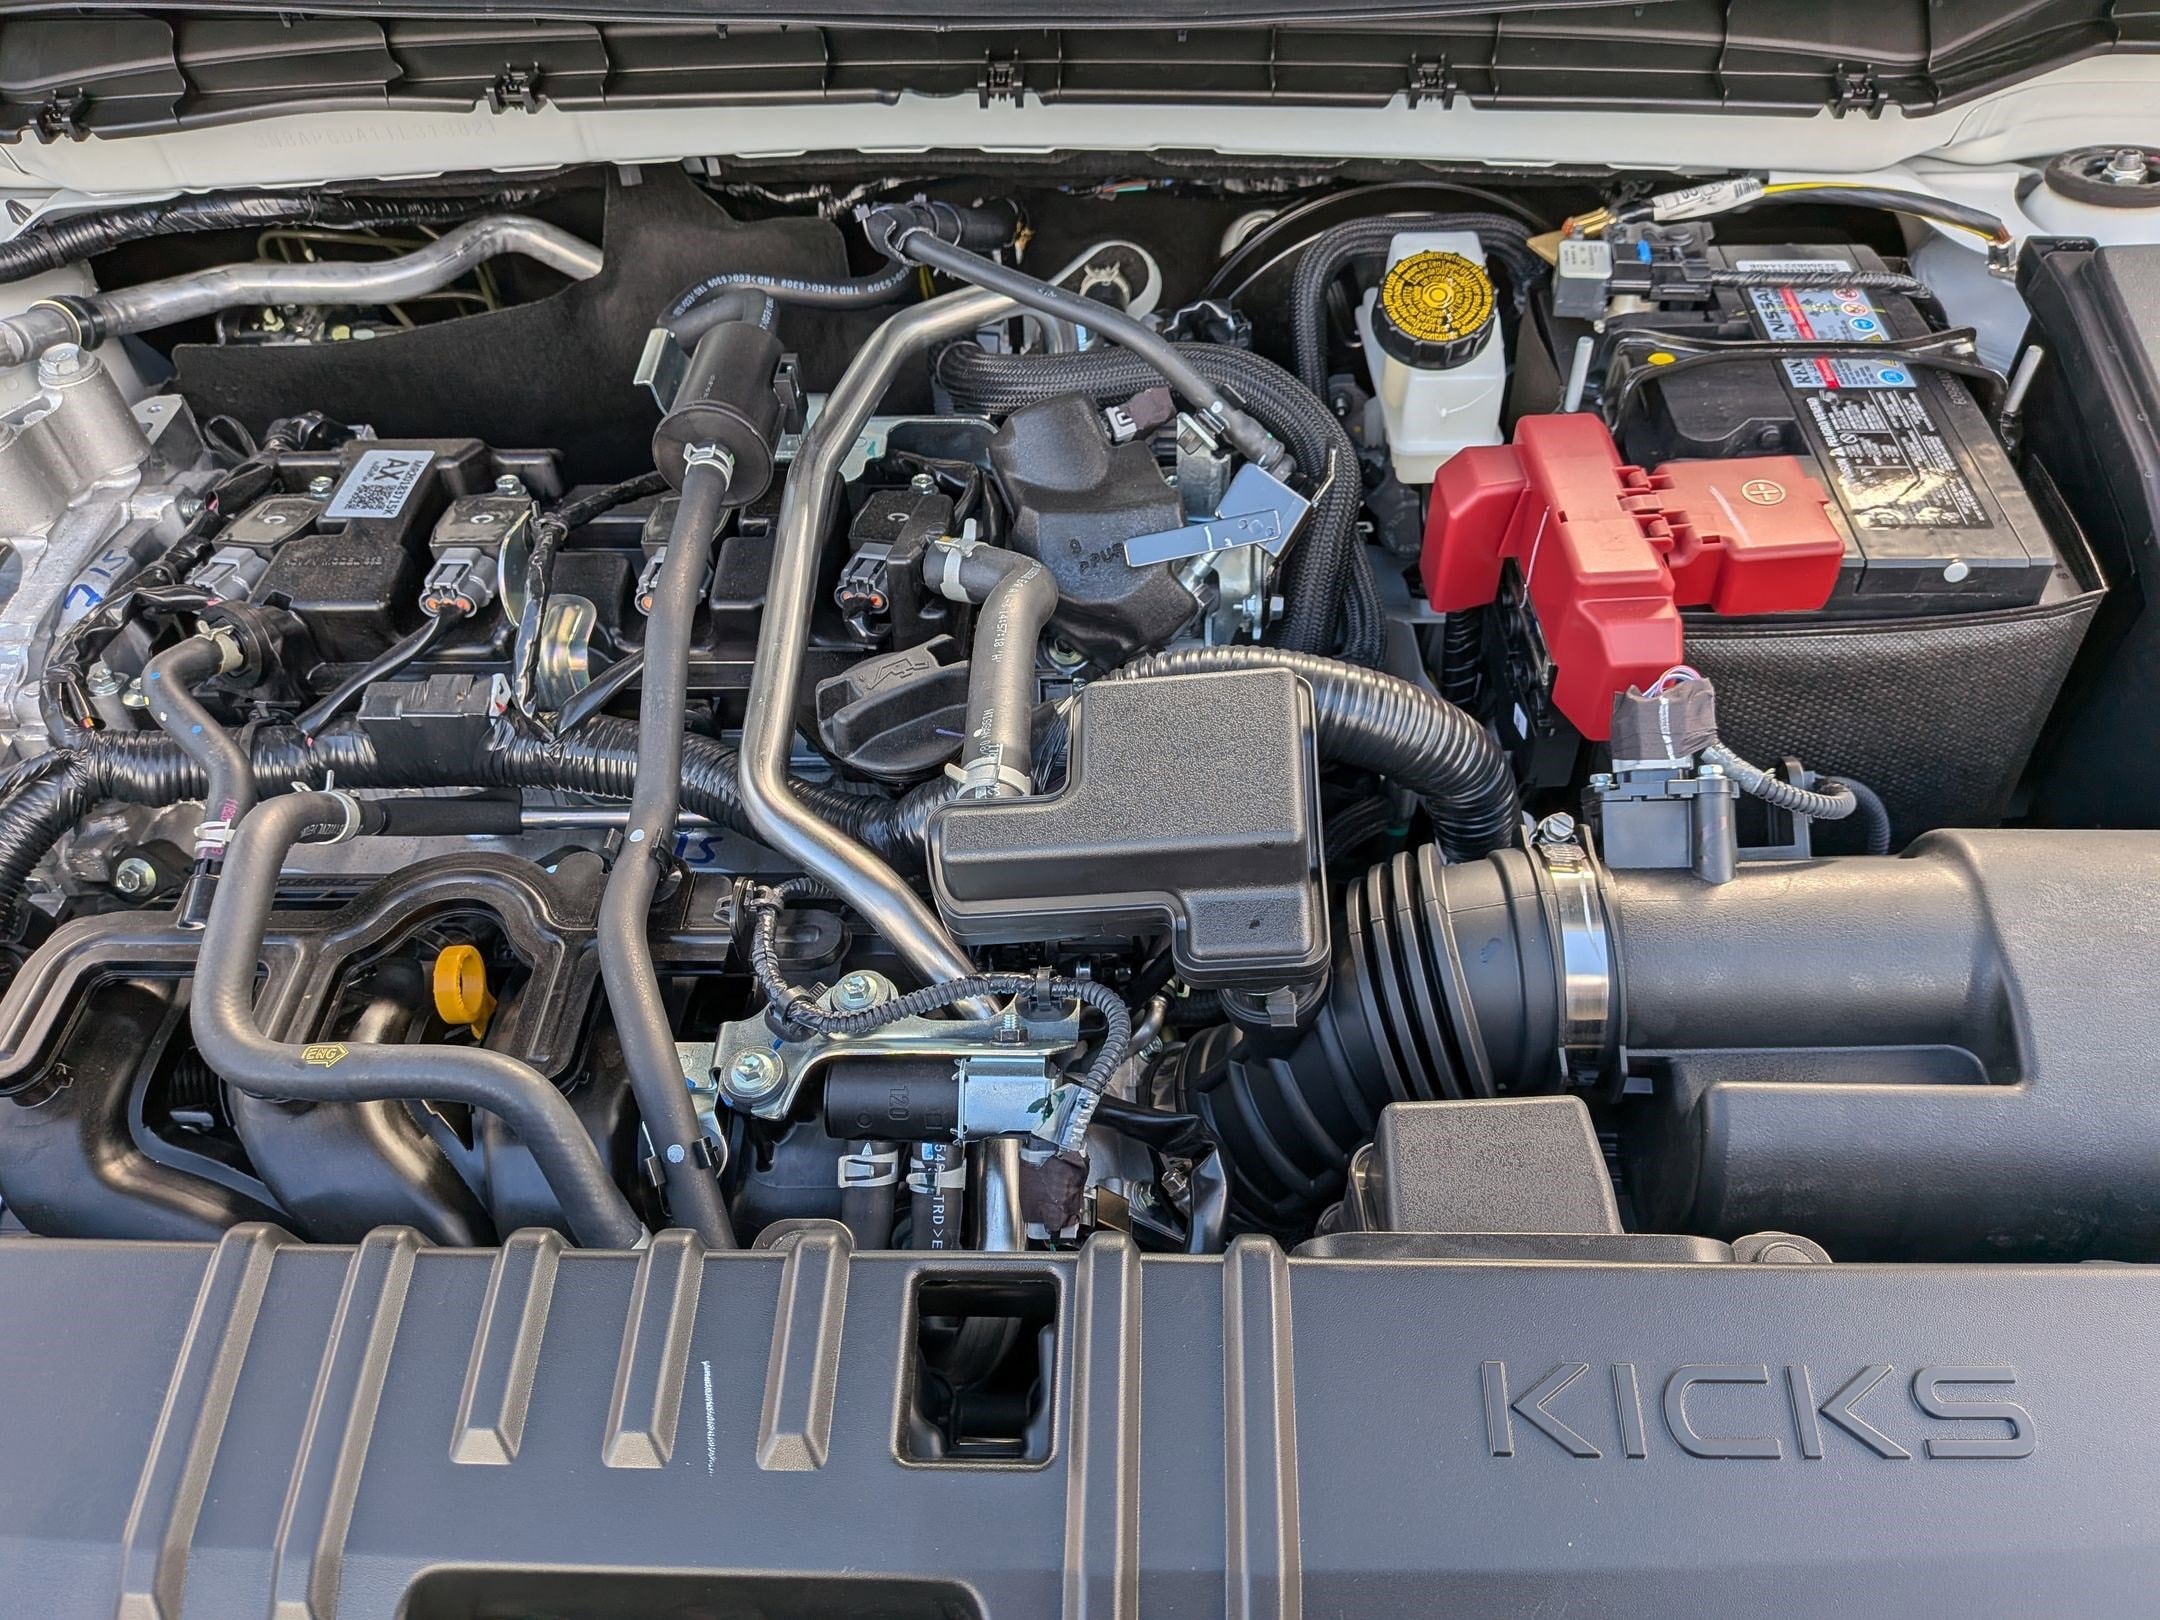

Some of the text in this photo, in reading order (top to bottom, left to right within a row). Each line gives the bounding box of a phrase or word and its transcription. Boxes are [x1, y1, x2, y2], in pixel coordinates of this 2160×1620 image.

[374, 458, 410, 481] AX
[980, 707, 994, 739] NISSAN
[306, 1048, 337, 1060] ENG
[888, 1086, 910, 1120] 120
[1481, 1360, 2037, 1461] KICKS
